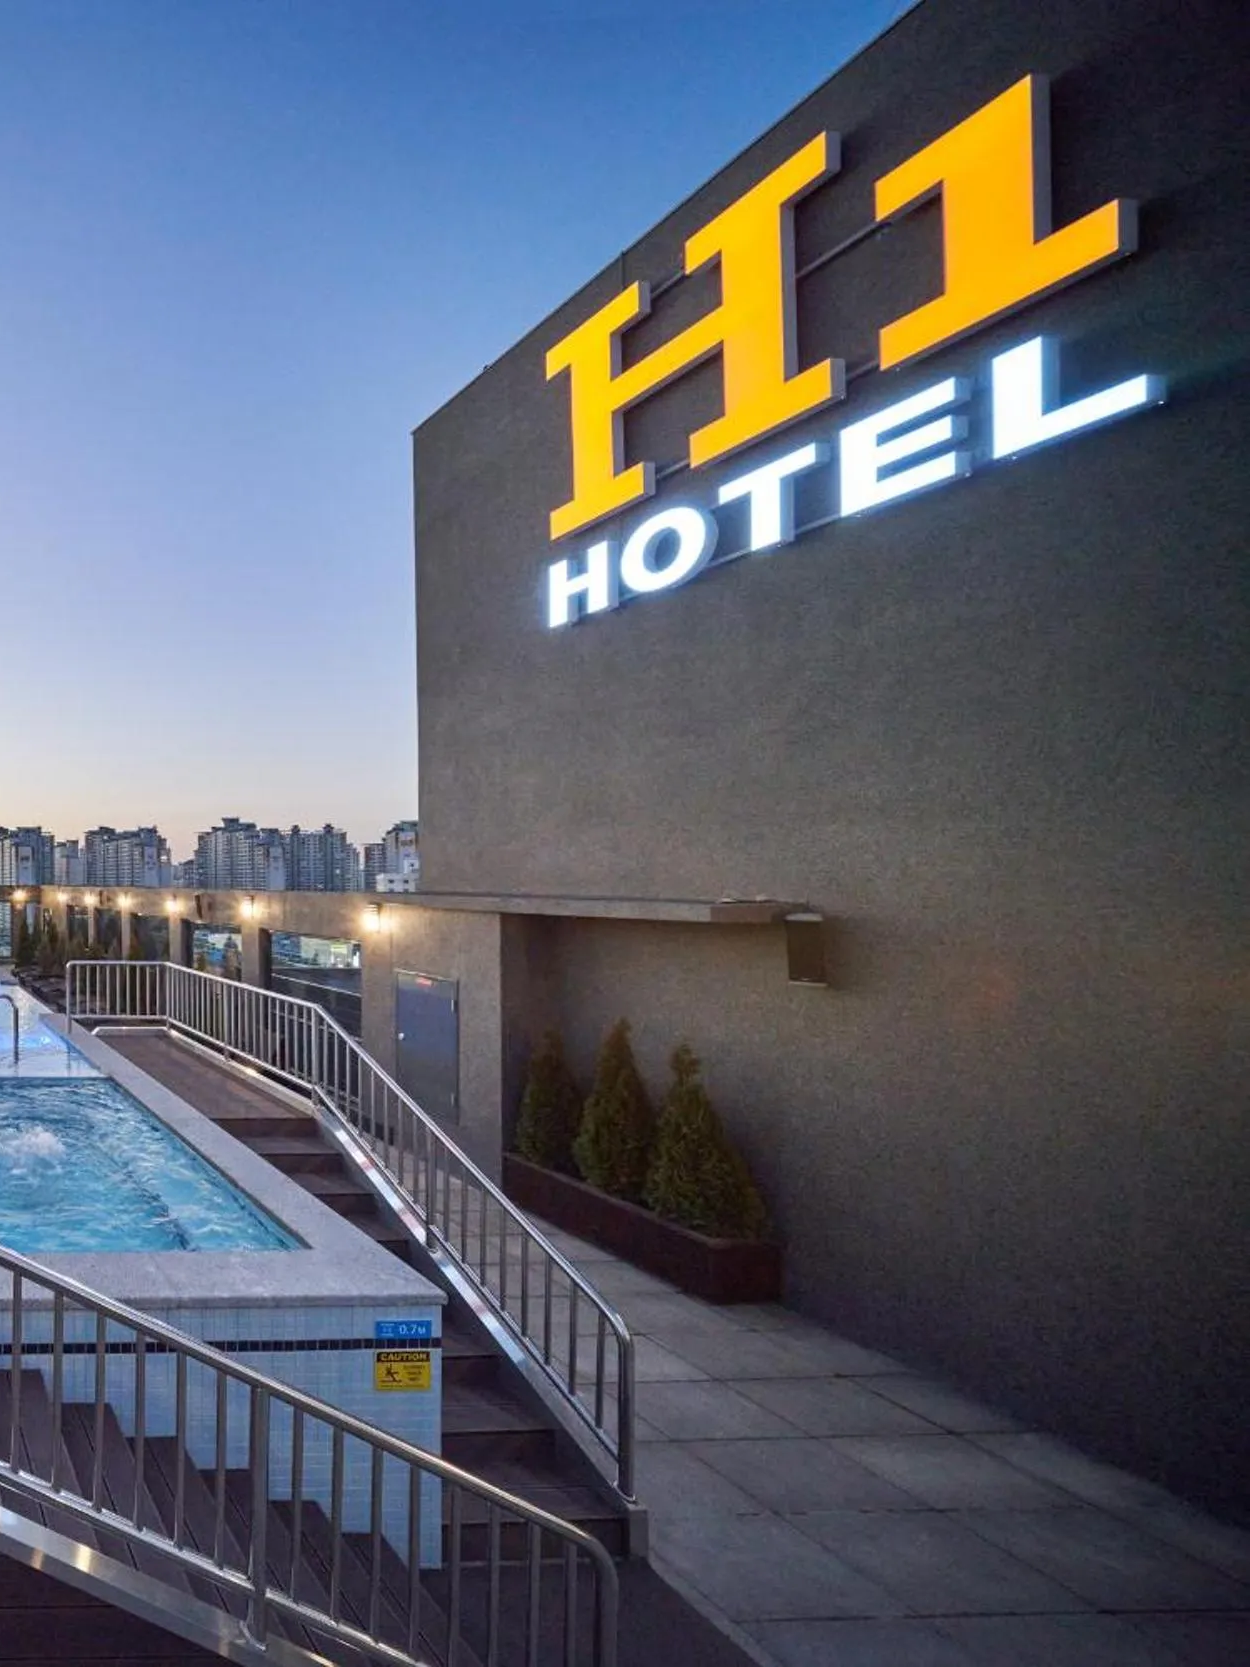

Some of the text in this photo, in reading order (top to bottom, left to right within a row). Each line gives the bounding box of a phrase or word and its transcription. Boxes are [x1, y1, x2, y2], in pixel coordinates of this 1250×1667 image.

[546, 74, 1134, 540] H1
[547, 336, 1158, 630] HOTEL
[381, 1352, 428, 1361] CAUTION
